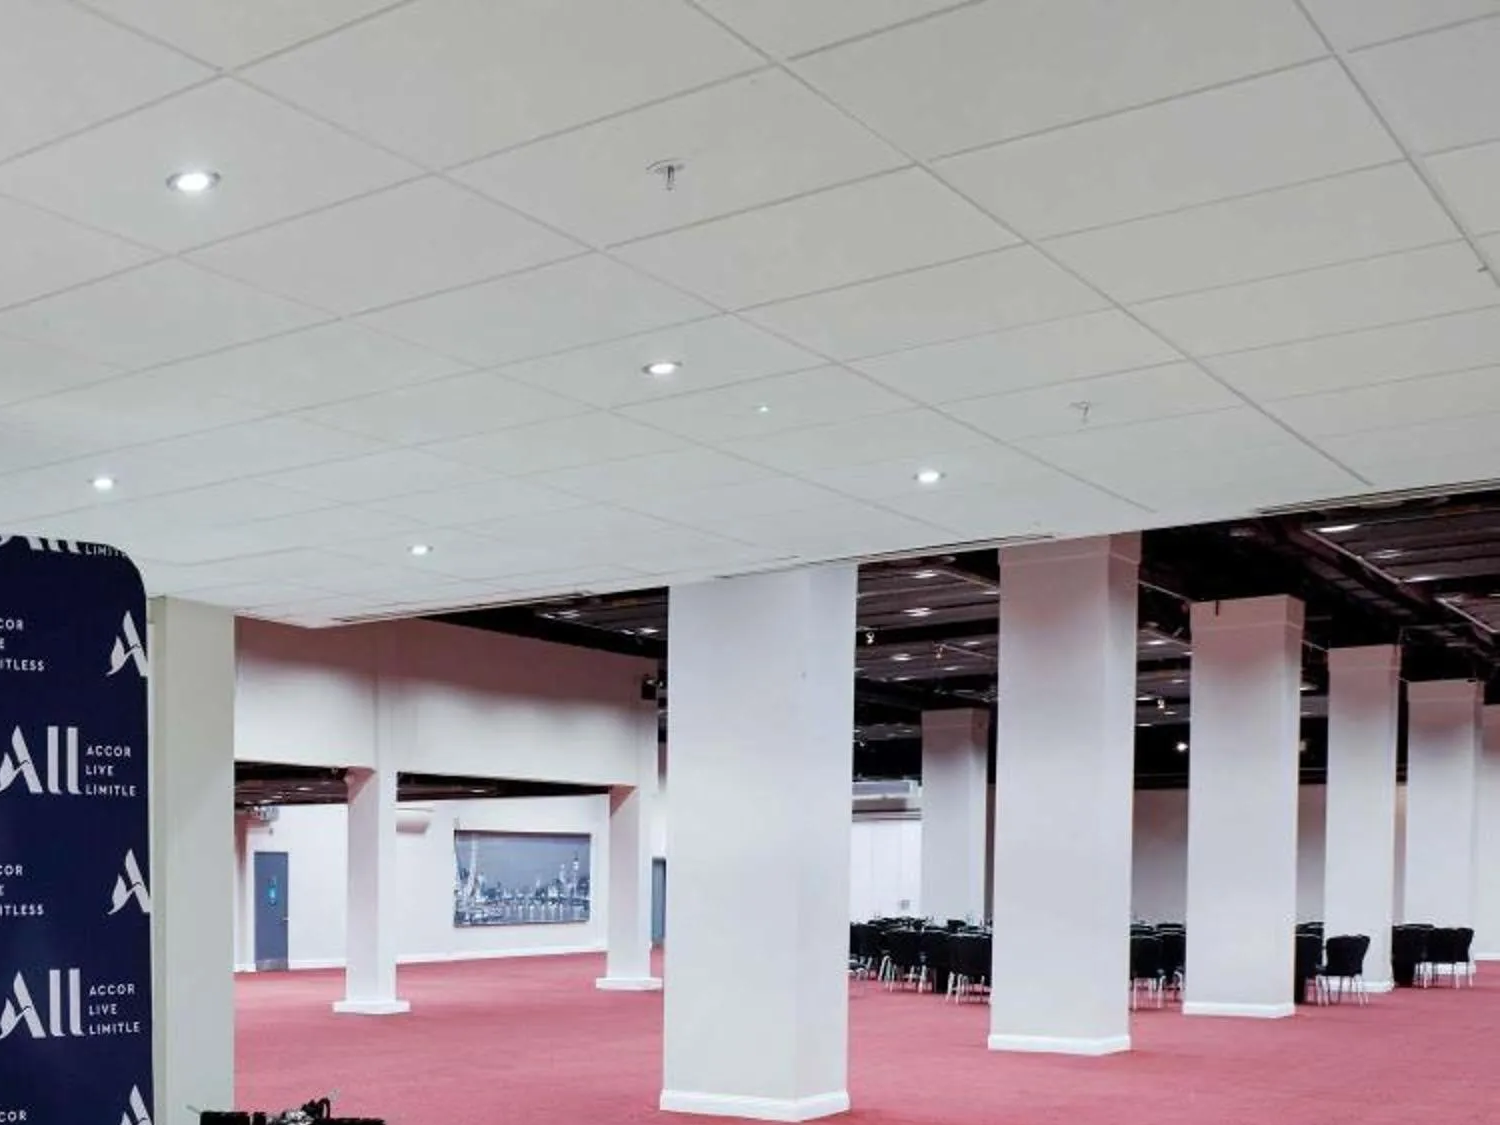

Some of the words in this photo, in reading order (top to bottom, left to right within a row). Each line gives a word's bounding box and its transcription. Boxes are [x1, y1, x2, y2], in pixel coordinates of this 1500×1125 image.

[86, 745, 131, 758] ACCOR
[85, 765, 115, 777] LIVE
[88, 983, 136, 997] ACCOR
[88, 1003, 118, 1017] LIVE
